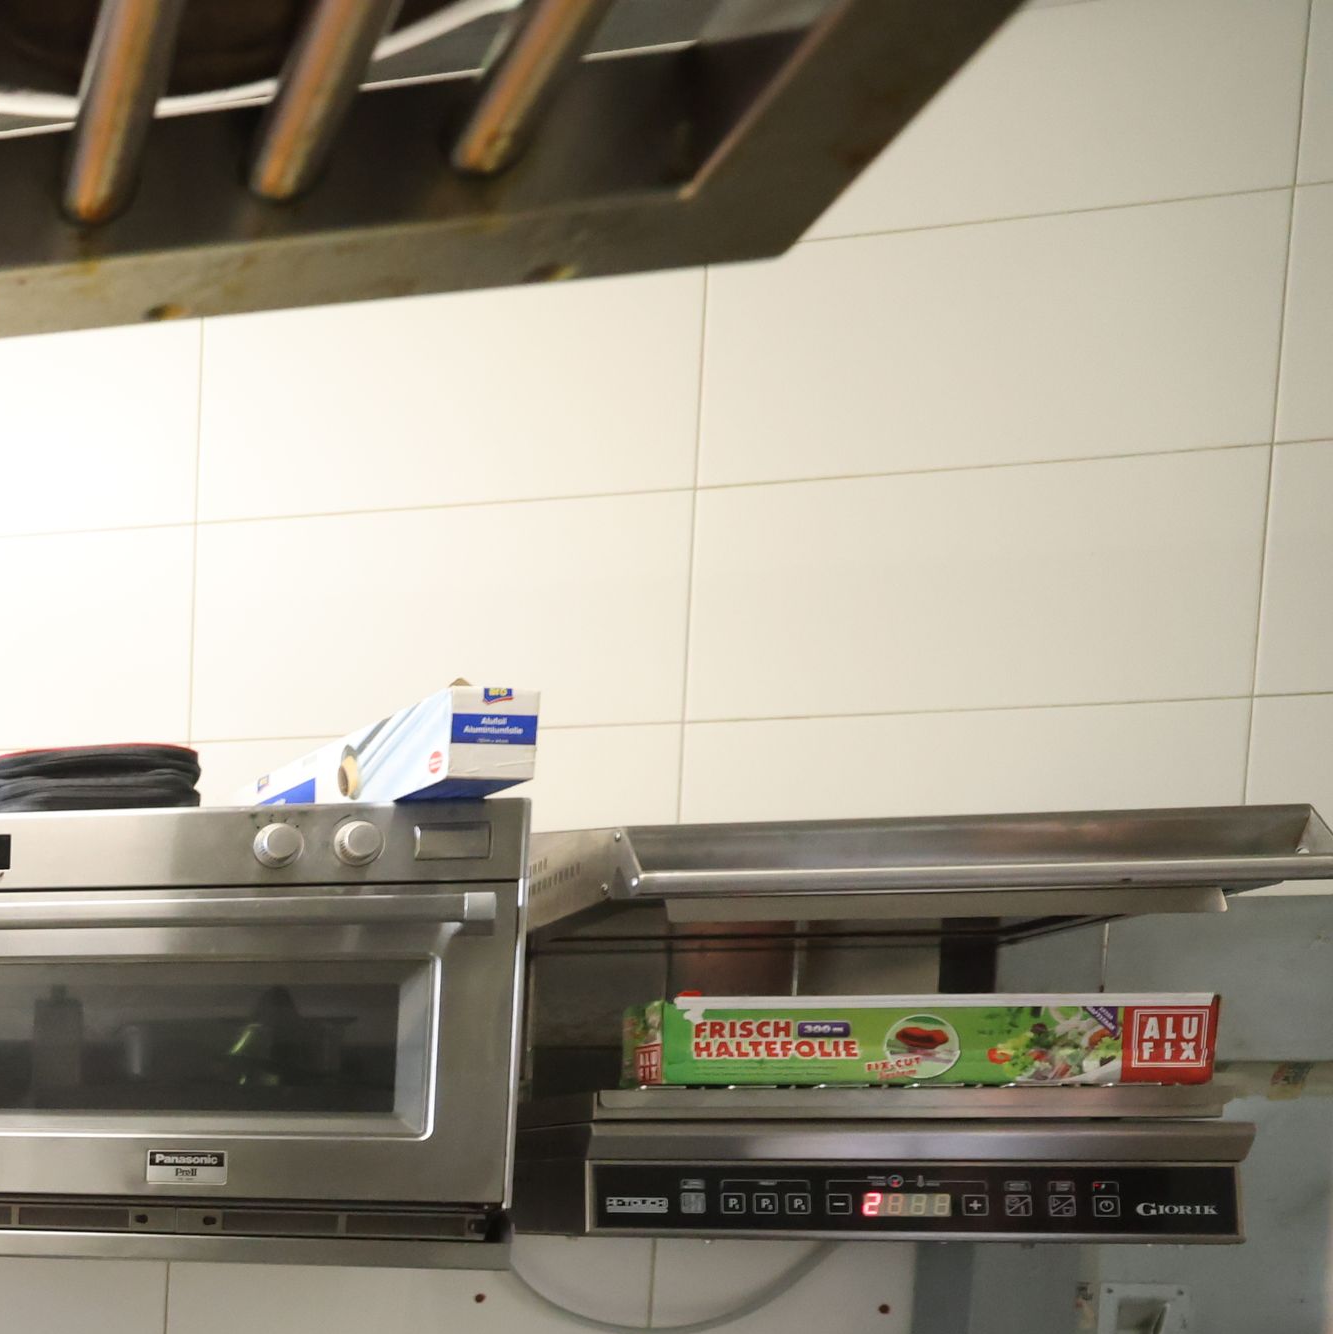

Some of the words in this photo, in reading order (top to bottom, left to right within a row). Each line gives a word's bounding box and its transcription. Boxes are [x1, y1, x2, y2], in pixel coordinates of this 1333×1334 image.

[694, 1021, 792, 1039] FRISCH
[1143, 1016, 1199, 1040] ALU
[694, 1041, 858, 1058] HALTEFOLIE
[1143, 1042, 1196, 1060] FIX
[155, 1153, 218, 1164] Panasonic
[1136, 1202, 1218, 1216] GIORIK
